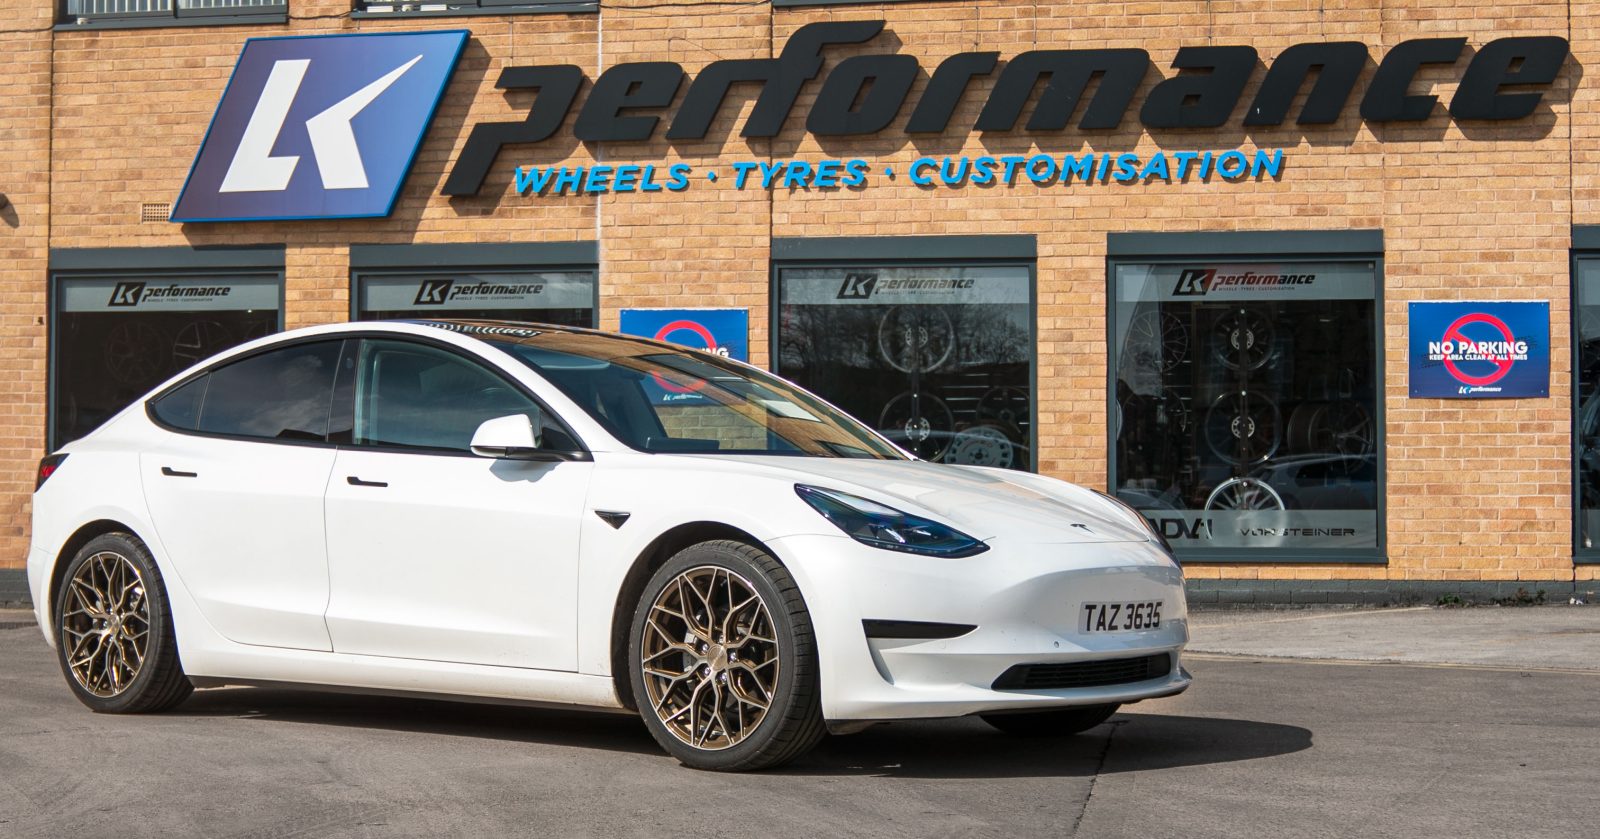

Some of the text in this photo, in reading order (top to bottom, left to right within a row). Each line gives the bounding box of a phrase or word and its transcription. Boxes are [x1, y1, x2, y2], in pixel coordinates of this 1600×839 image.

[217, 20, 1569, 196] LK performance
[514, 149, 1284, 194] WHEELS TYRES CUSTOMISATION
[449, 281, 544, 300] performance
[1211, 271, 1316, 292] performance
[141, 283, 231, 303] performance
[1429, 341, 1528, 354] NO PARKING
[1085, 601, 1163, 631] TAZ 3635
